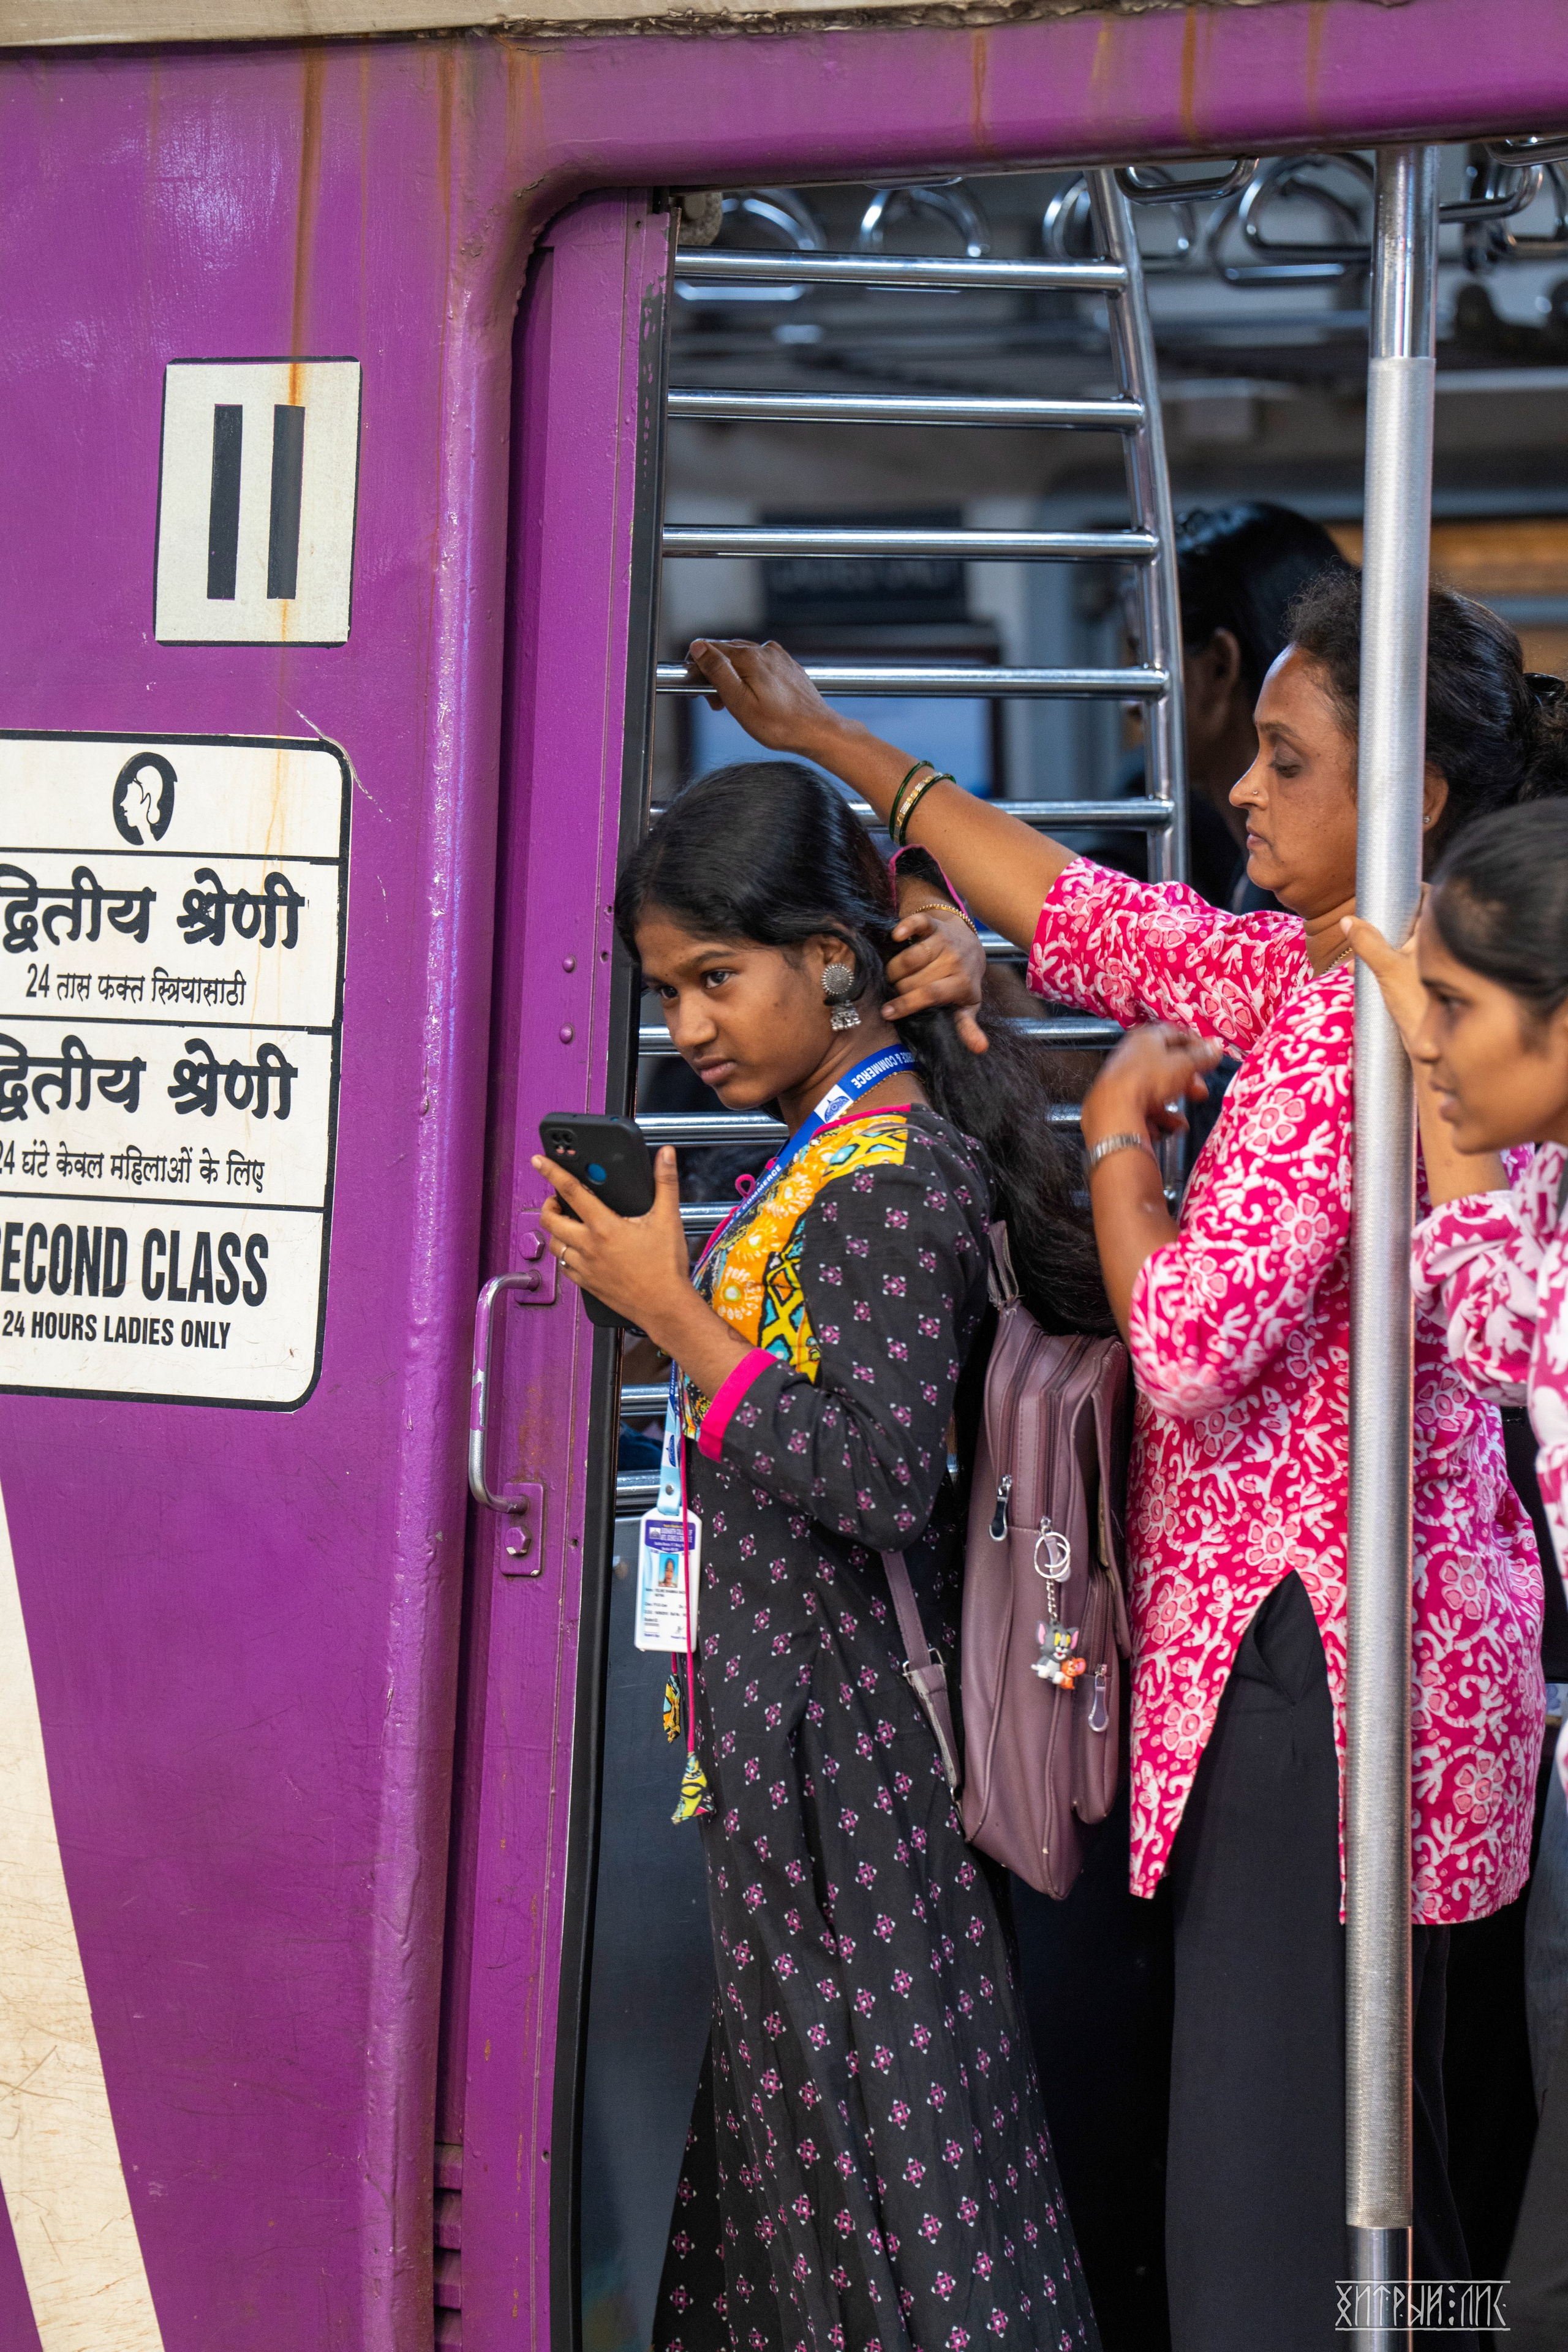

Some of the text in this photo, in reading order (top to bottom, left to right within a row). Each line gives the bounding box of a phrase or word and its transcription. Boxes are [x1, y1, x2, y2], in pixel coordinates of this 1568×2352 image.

[0, 863, 305, 954] द्वितीय श्रेणी
[26, 963, 247, 1007] 24 तास फक्त स्त्रियासाठी
[167, 1038, 298, 1120] श्रेणी
[850, 1055, 899, 1089] COMMERCE
[22, 1139, 50, 1178] घंटे
[56, 1140, 105, 1180] केवल
[110, 1144, 192, 1185] महिलाओं
[199, 1147, 220, 1185] के
[226, 1149, 265, 1193] लिए
[742, 1164, 782, 1210] COMMERCE
[0, 1222, 269, 1307] ECOND CLASS
[2, 1310, 231, 1349] 24 HOURS LADIES ONLY
